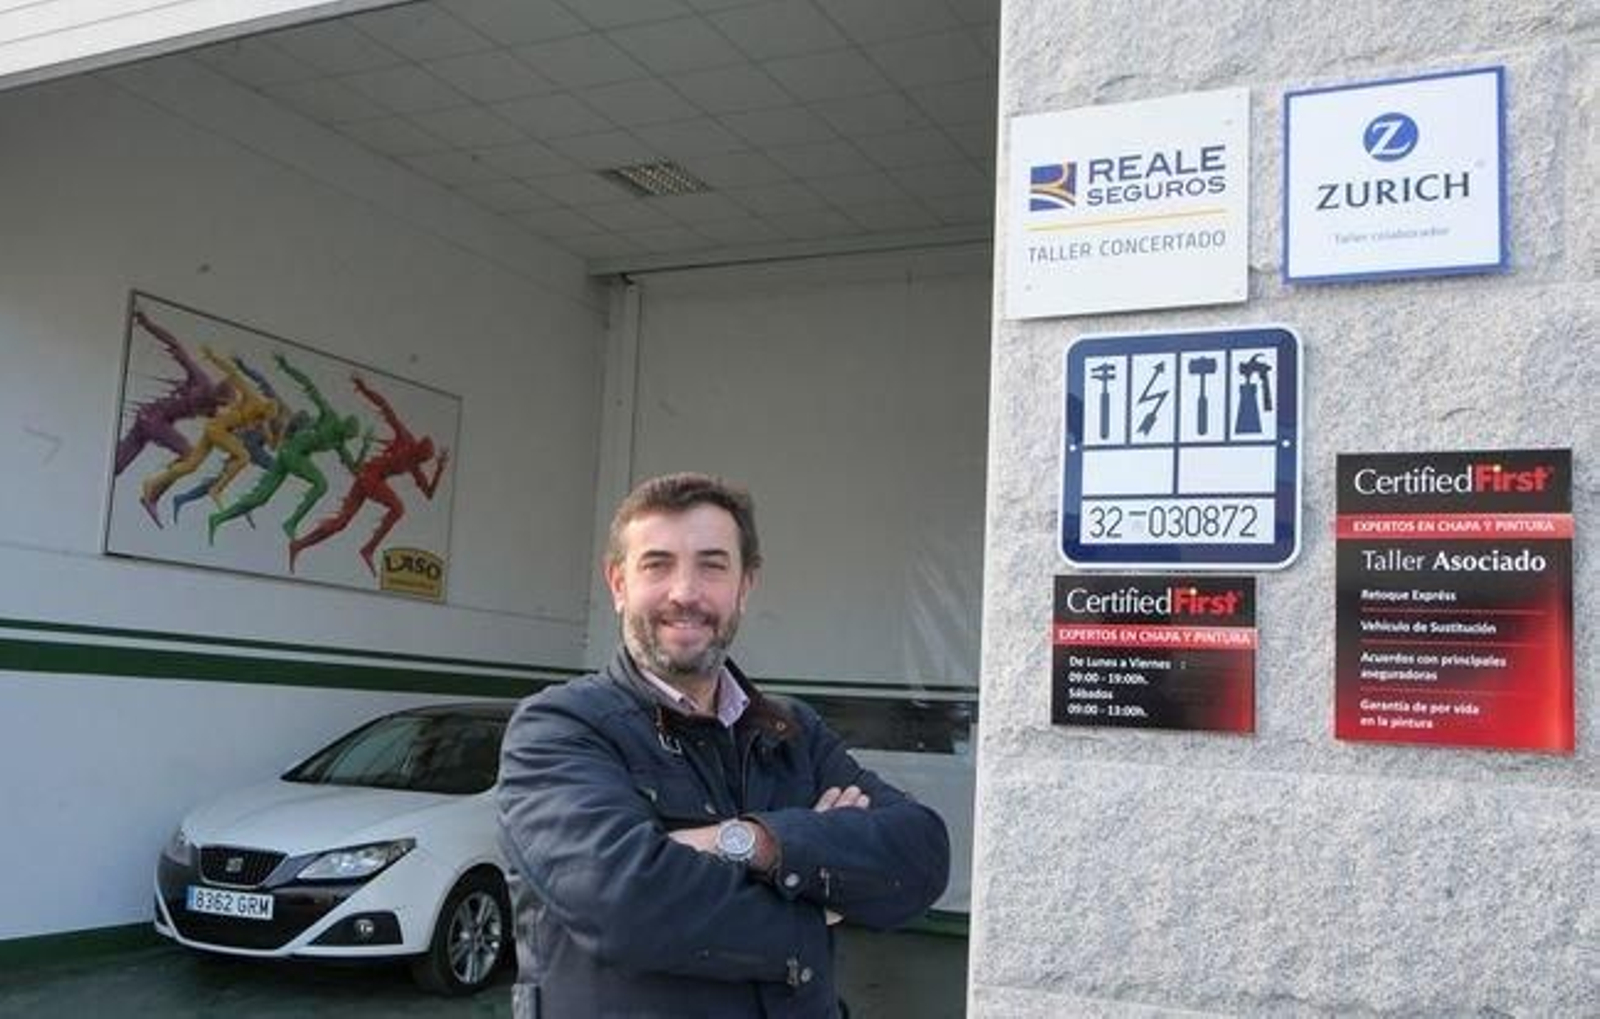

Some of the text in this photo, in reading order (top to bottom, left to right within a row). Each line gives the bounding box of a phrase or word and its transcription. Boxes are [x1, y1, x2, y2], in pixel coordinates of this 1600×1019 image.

[1088, 145, 1227, 184] REALE
[1086, 174, 1227, 207] SEGUROS
[1316, 172, 1471, 211] ZURICH
[1027, 229, 1226, 265] TALLER CONCERTADO
[1354, 464, 1550, 495] CertifiedFirst
[1353, 520, 1555, 532] EXPERTOS EN CHAPA Y PINTURA
[385, 555, 442, 581] LASO
[1362, 550, 1546, 572] Taller Asociado
[1066, 587, 1240, 616] CertifiedFirst
[1360, 589, 1409, 602] Retoque
[1360, 620, 1497, 635] Vehículo de Sustitución
[1059, 628, 1251, 645] EXPERTOS EN CHAPA Y PINTURA
[1069, 656, 1171, 670] De Lunes a Viernes
[1360, 652, 1506, 668] Acuerdos con principales
[1068, 673, 1099, 683] 09:00
[1360, 669, 1437, 682] aseguradoras
[1067, 705, 1099, 715] 09:00
[1360, 699, 1480, 715] Garantía de por vida
[1360, 715, 1434, 729] en la pintura
